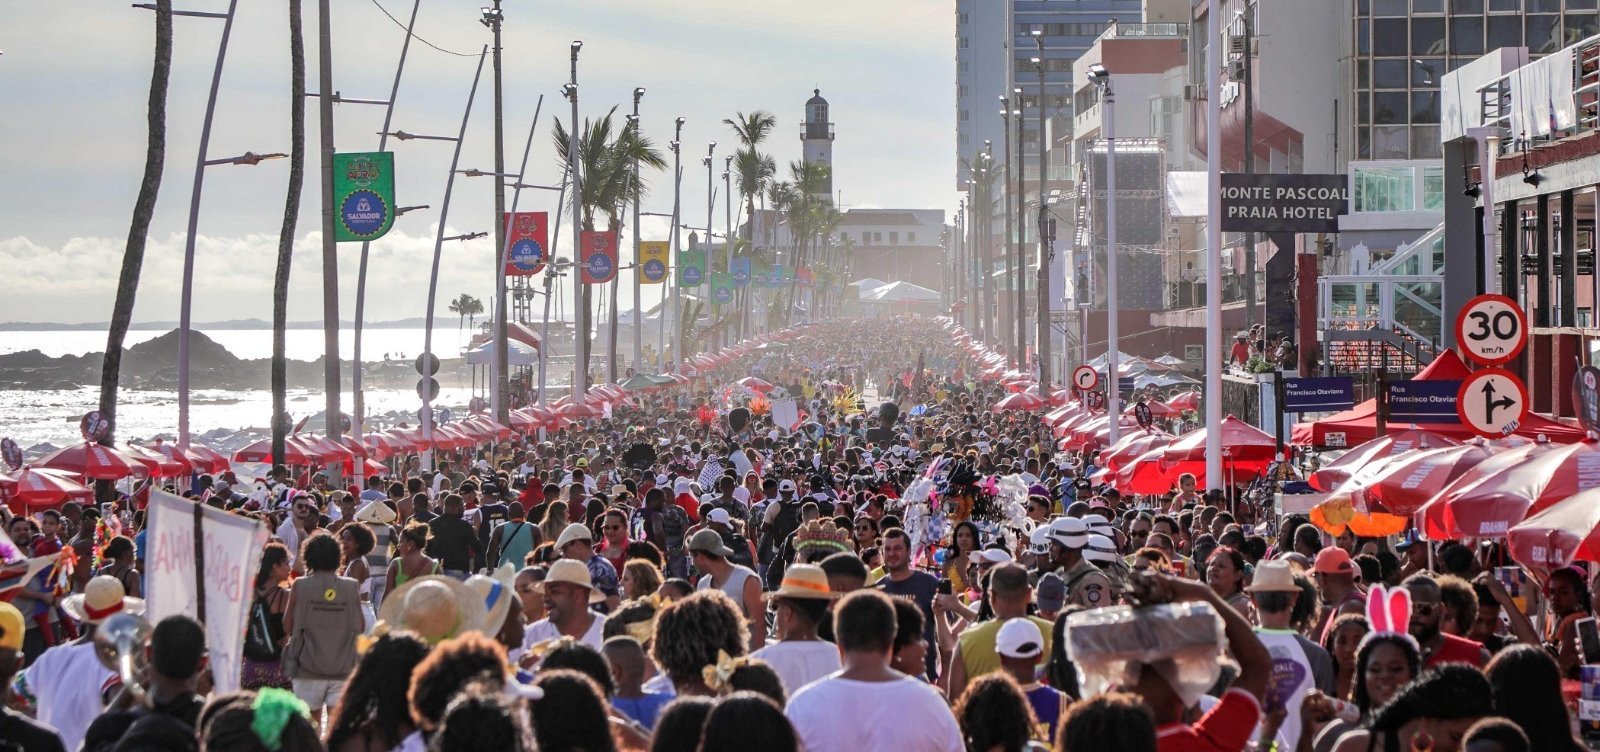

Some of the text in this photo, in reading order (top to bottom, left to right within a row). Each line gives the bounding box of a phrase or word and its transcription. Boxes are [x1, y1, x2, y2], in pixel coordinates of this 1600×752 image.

[1276, 187, 1348, 200] PASCOAL
[347, 212, 380, 220] SALVADOR
[1228, 206, 1334, 219] PRAIA HOTEL
[1468, 310, 1518, 341] 30
[1391, 395, 1458, 403] Francisco Otavian
[1479, 521, 1508, 534] BRAHMA
